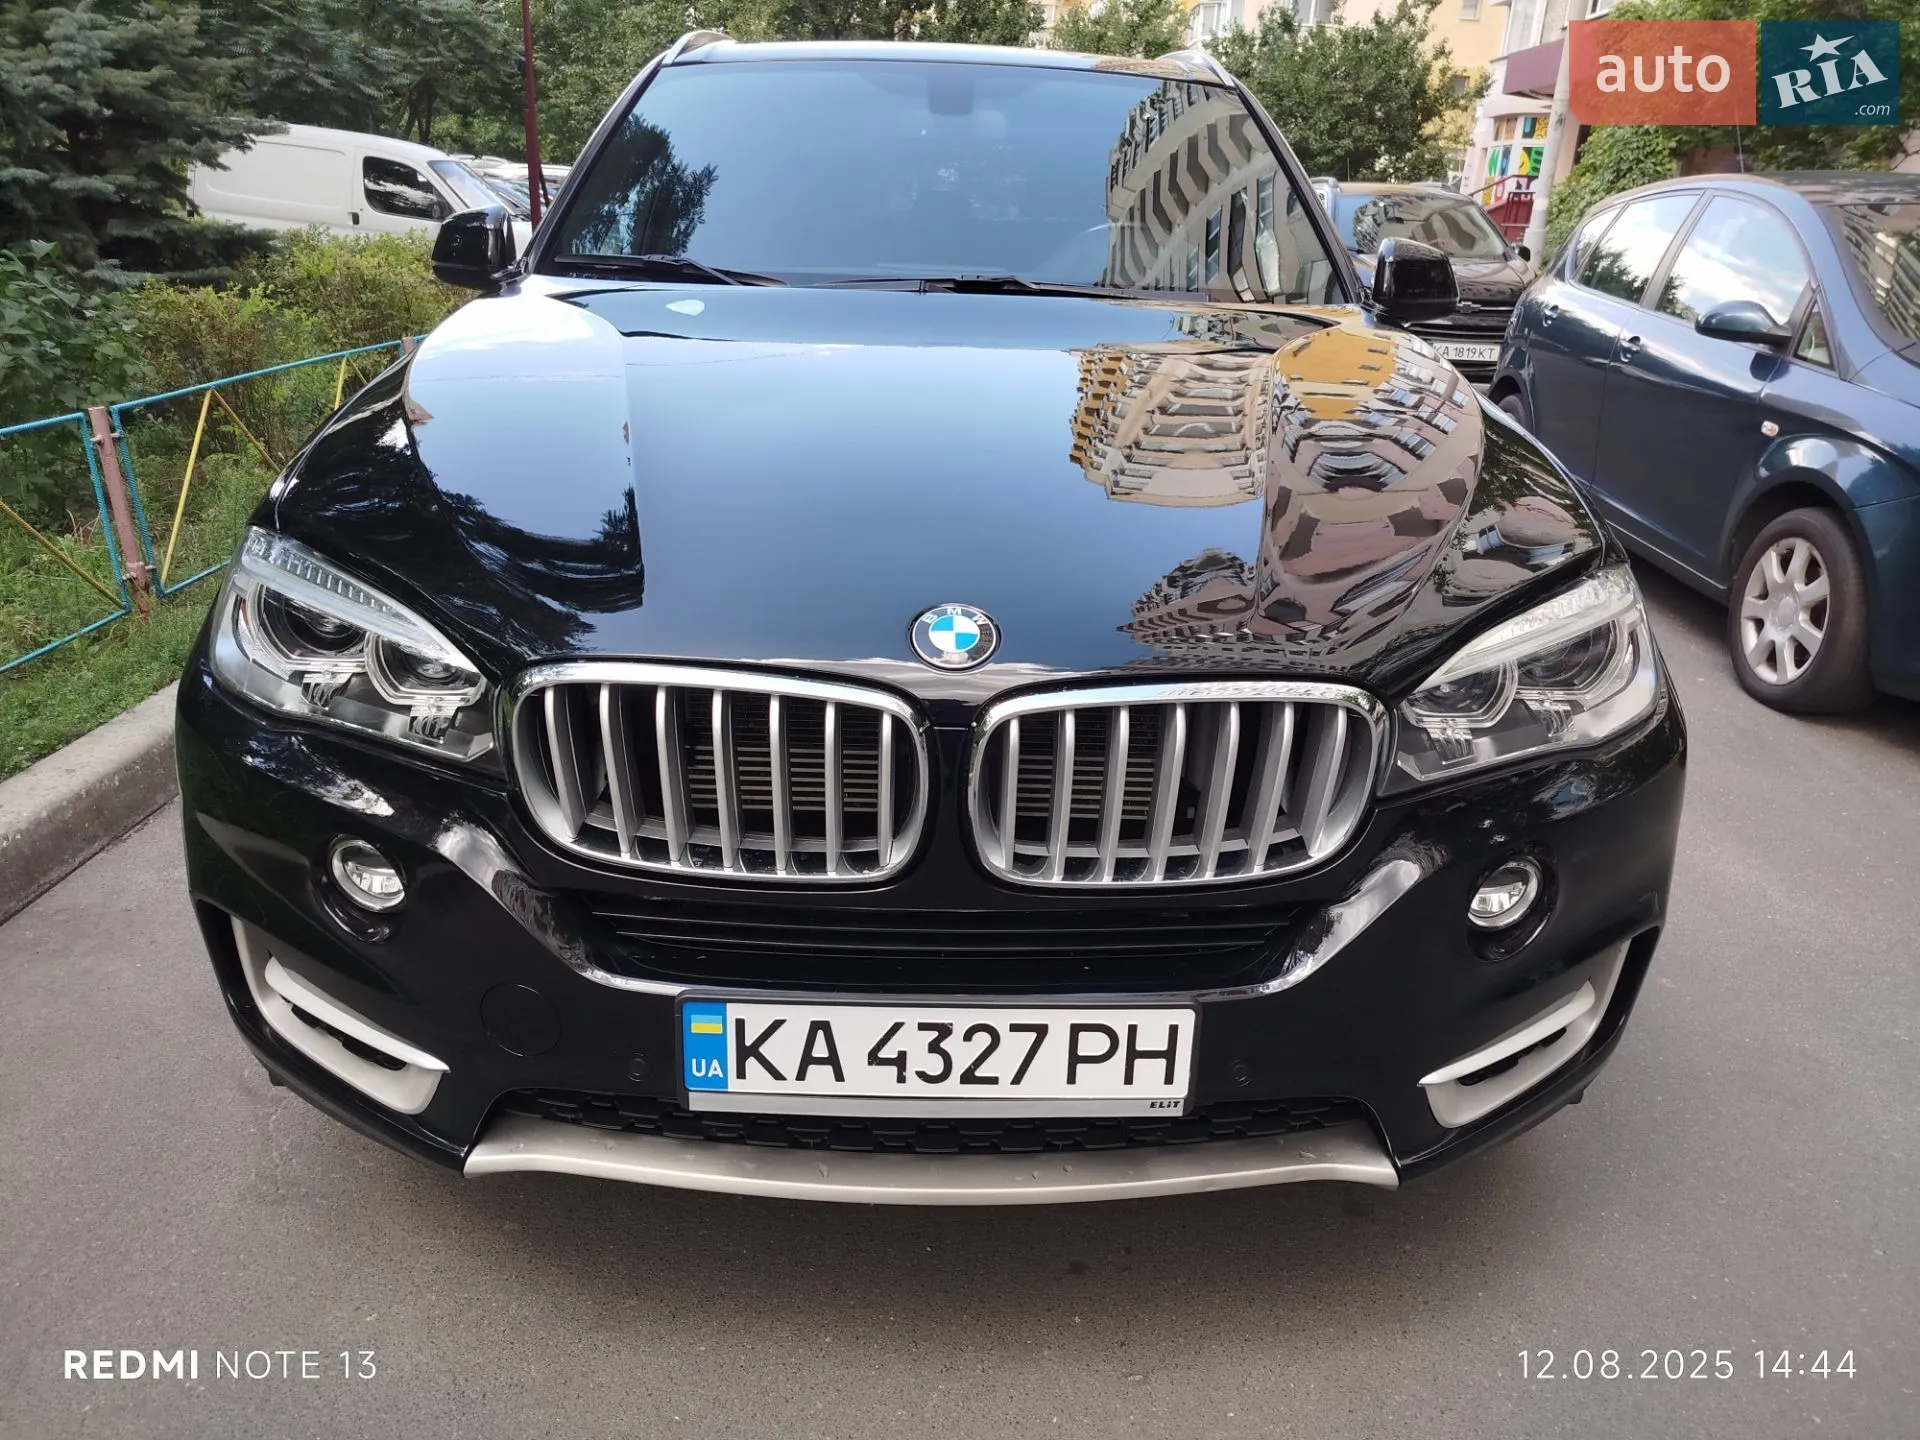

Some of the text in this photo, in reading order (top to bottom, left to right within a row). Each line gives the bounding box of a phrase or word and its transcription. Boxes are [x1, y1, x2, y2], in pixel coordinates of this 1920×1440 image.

[921, 606, 989, 626] BMW
[735, 1018, 1181, 1086] KA 4327 PH
[691, 1058, 724, 1078] UA
